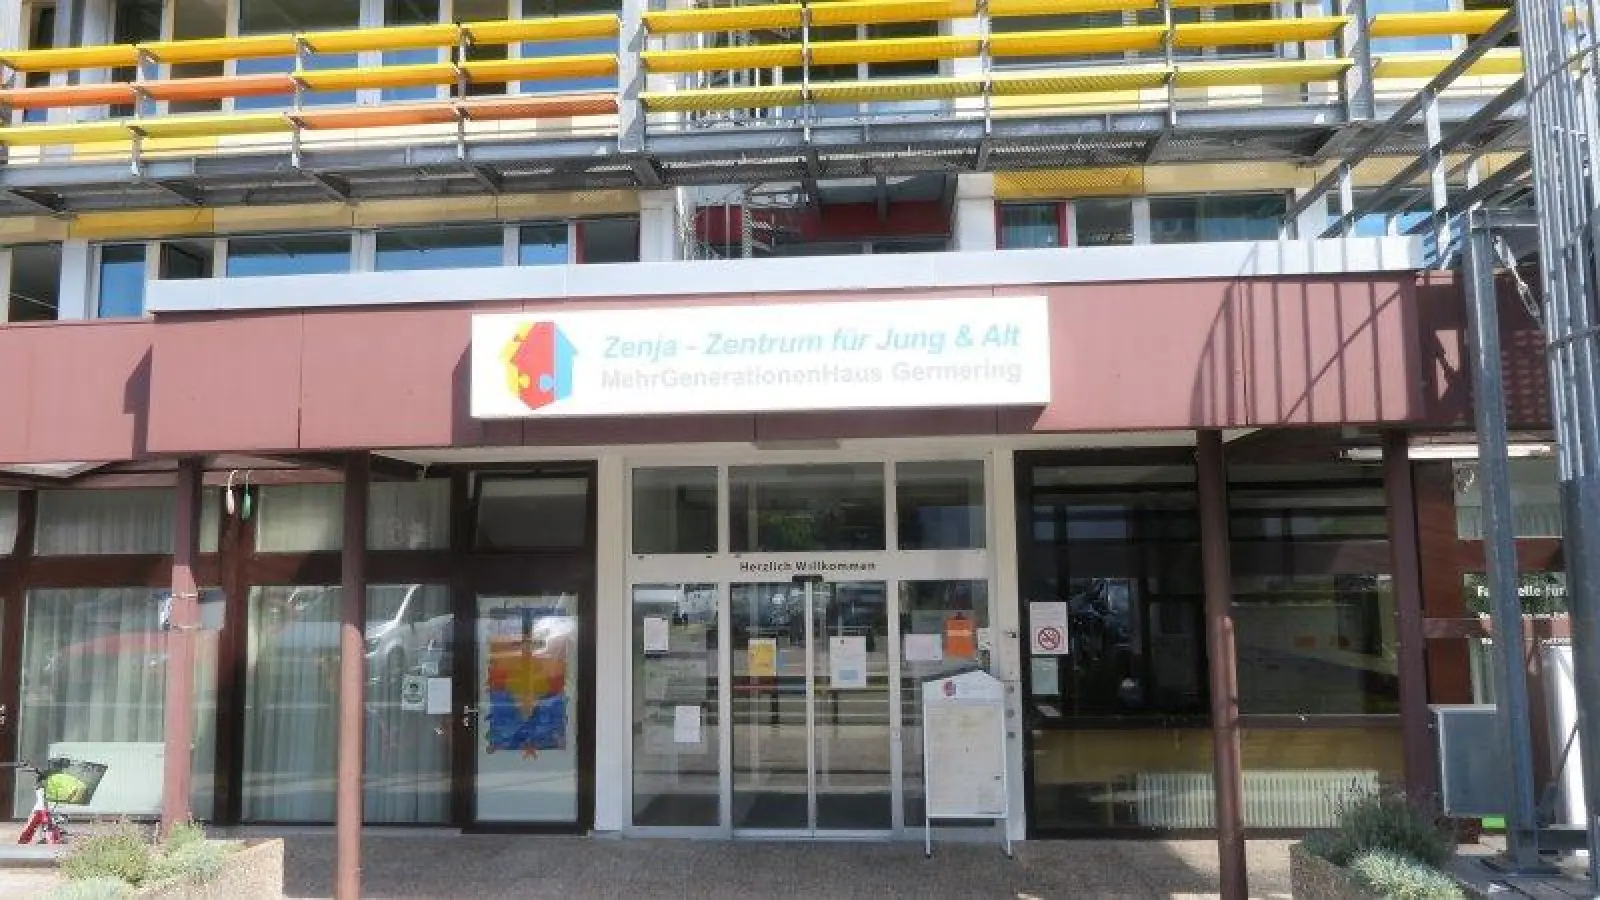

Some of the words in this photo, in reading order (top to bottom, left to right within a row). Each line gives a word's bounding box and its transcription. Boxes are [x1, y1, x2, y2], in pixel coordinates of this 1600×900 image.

[603, 334, 678, 363] Zenja
[702, 331, 823, 356] Zentrum
[831, 327, 871, 352] für
[875, 326, 946, 355] Jung
[953, 323, 974, 348] &
[981, 321, 1022, 347] Alt
[600, 363, 884, 391] MehrGenerationenHaus
[891, 358, 1023, 386] Germering
[739, 561, 793, 572] Herzlich
[795, 560, 876, 572] Willkommen
